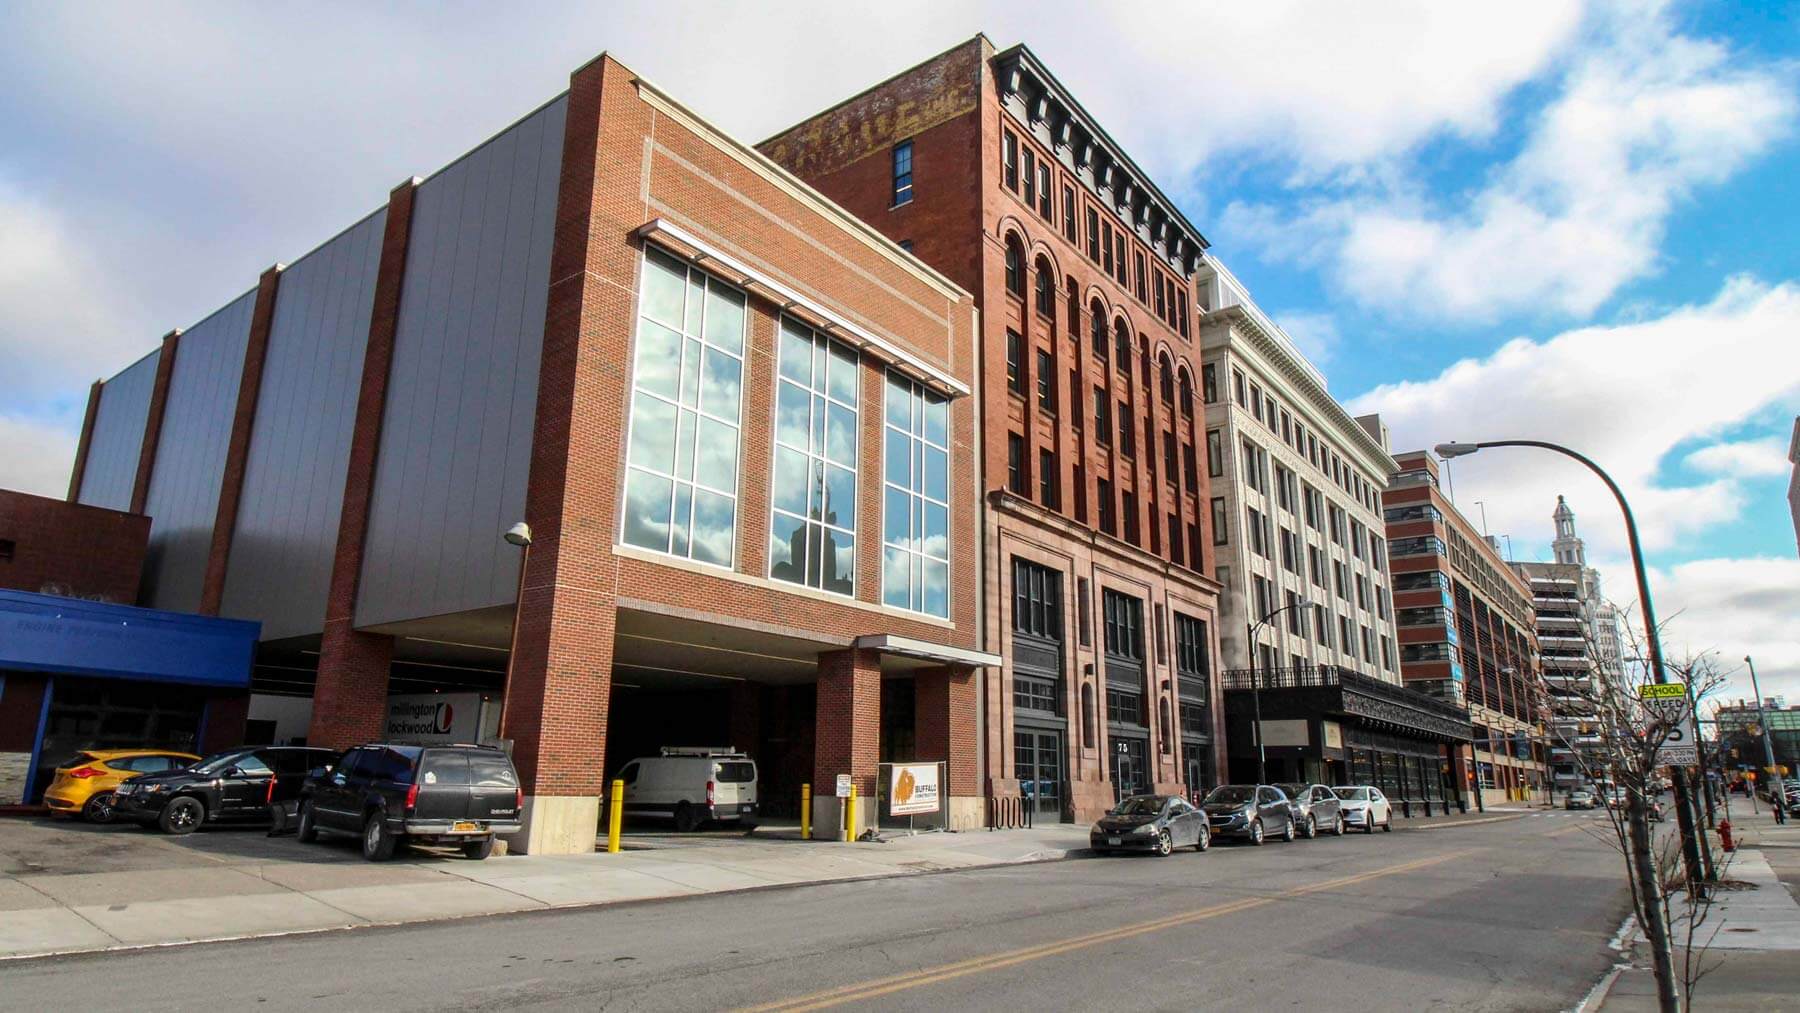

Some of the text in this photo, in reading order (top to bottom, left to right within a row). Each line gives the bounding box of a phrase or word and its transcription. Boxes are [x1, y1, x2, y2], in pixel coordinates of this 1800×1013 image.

[1643, 686, 1682, 696] SCHOOL
[391, 703, 436, 719] millington
[388, 720, 433, 734] lockwood
[1118, 743, 1128, 753] 75
[915, 784, 936, 792] BUFFALO
